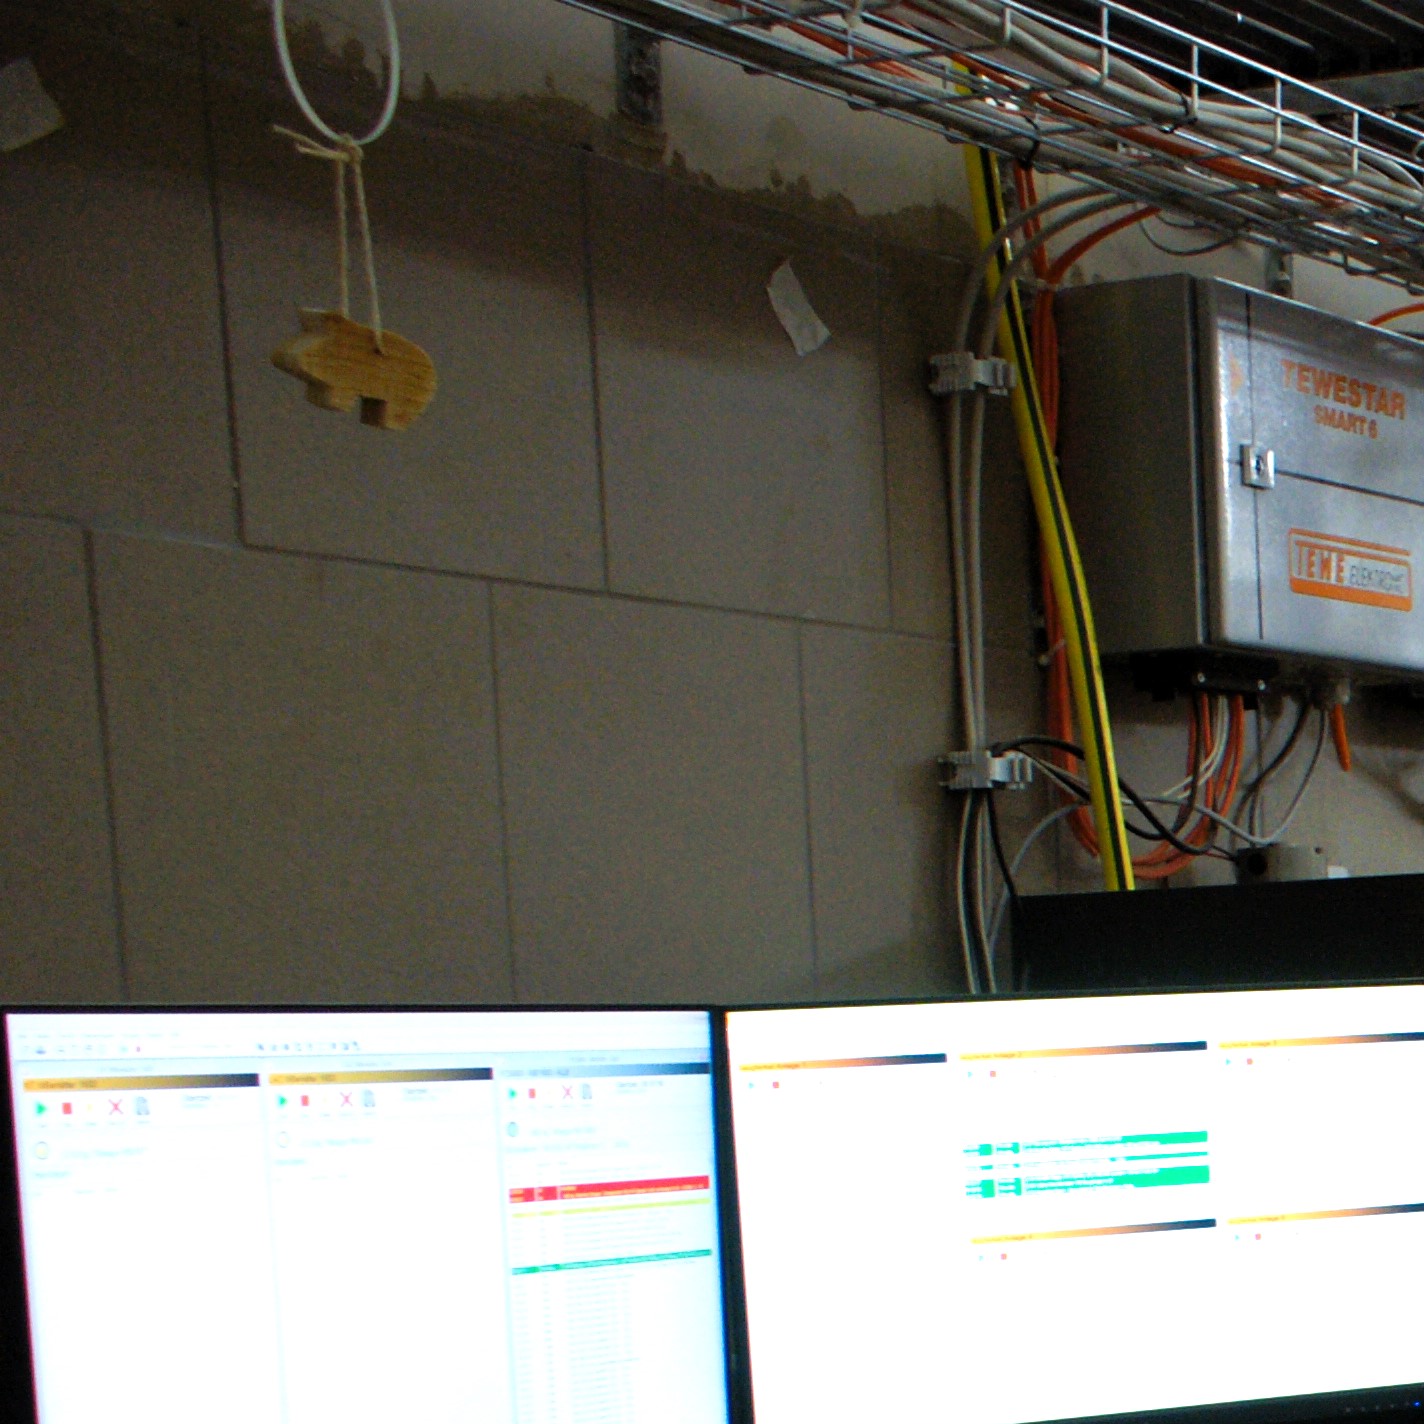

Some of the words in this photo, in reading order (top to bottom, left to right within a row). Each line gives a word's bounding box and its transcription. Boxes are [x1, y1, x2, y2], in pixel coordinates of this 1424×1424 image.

[1281, 359, 1406, 420] TEWESTAR
[1313, 404, 1367, 435] SMART
[1295, 540, 1345, 583] TEWE
